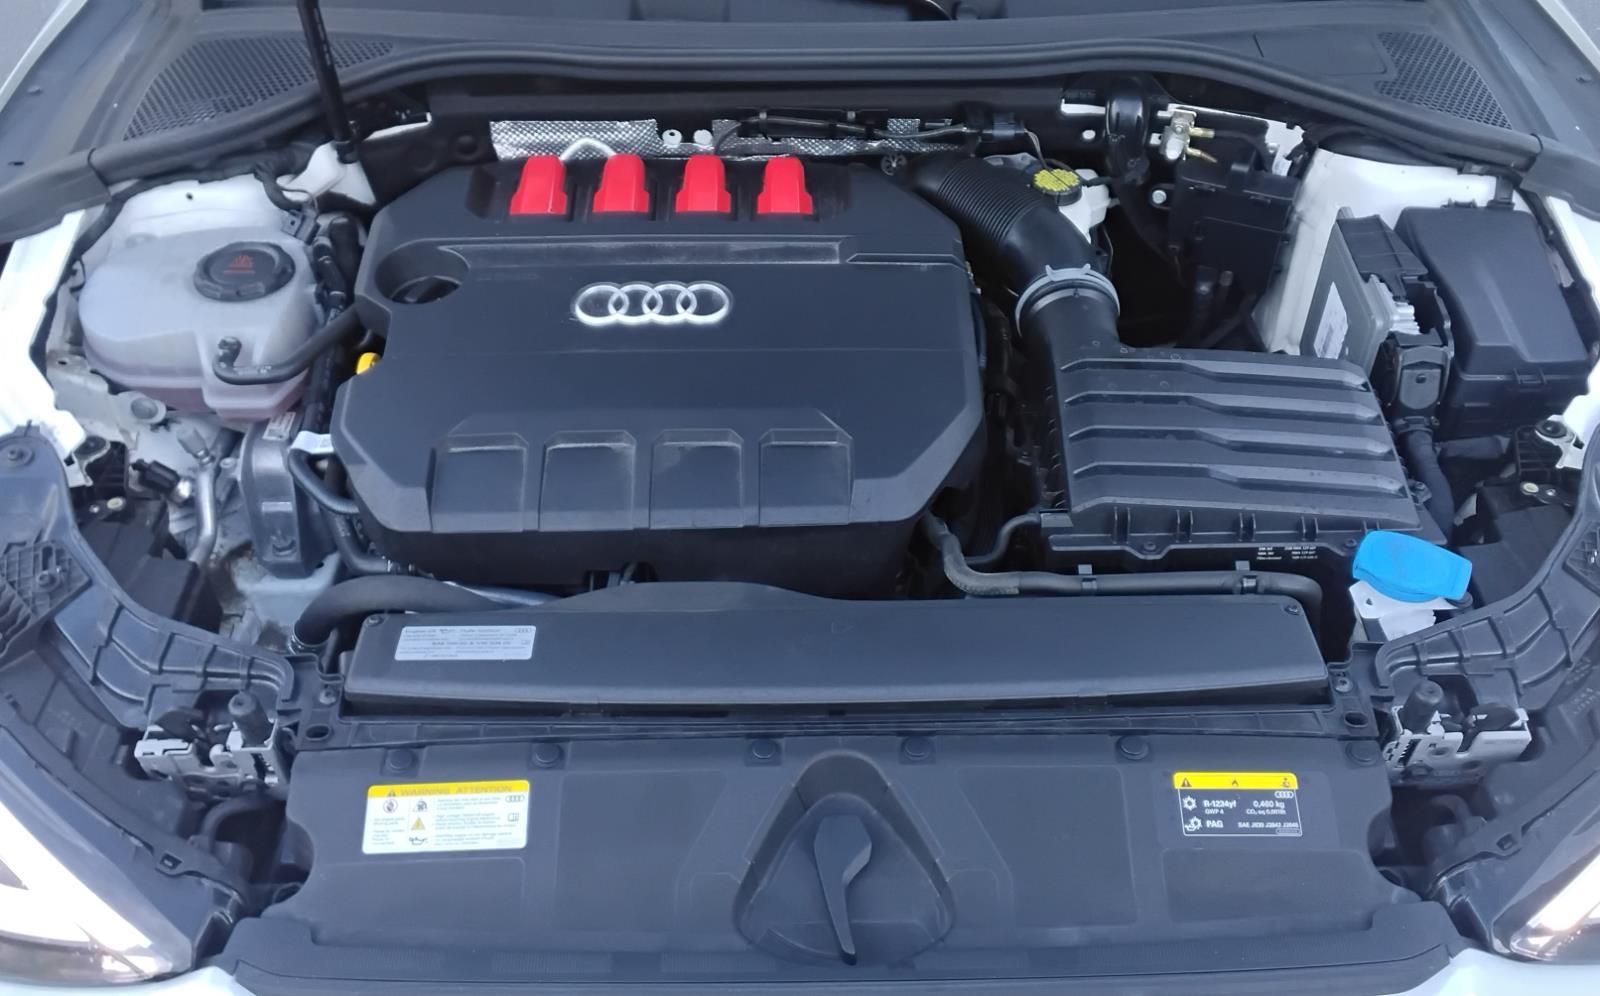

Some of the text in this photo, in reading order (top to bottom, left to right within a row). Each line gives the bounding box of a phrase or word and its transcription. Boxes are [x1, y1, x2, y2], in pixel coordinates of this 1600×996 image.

[400, 785, 513, 796] WARNING ATTENTION
[1275, 800, 1285, 810] kg
[1206, 820, 1224, 829] PAG
